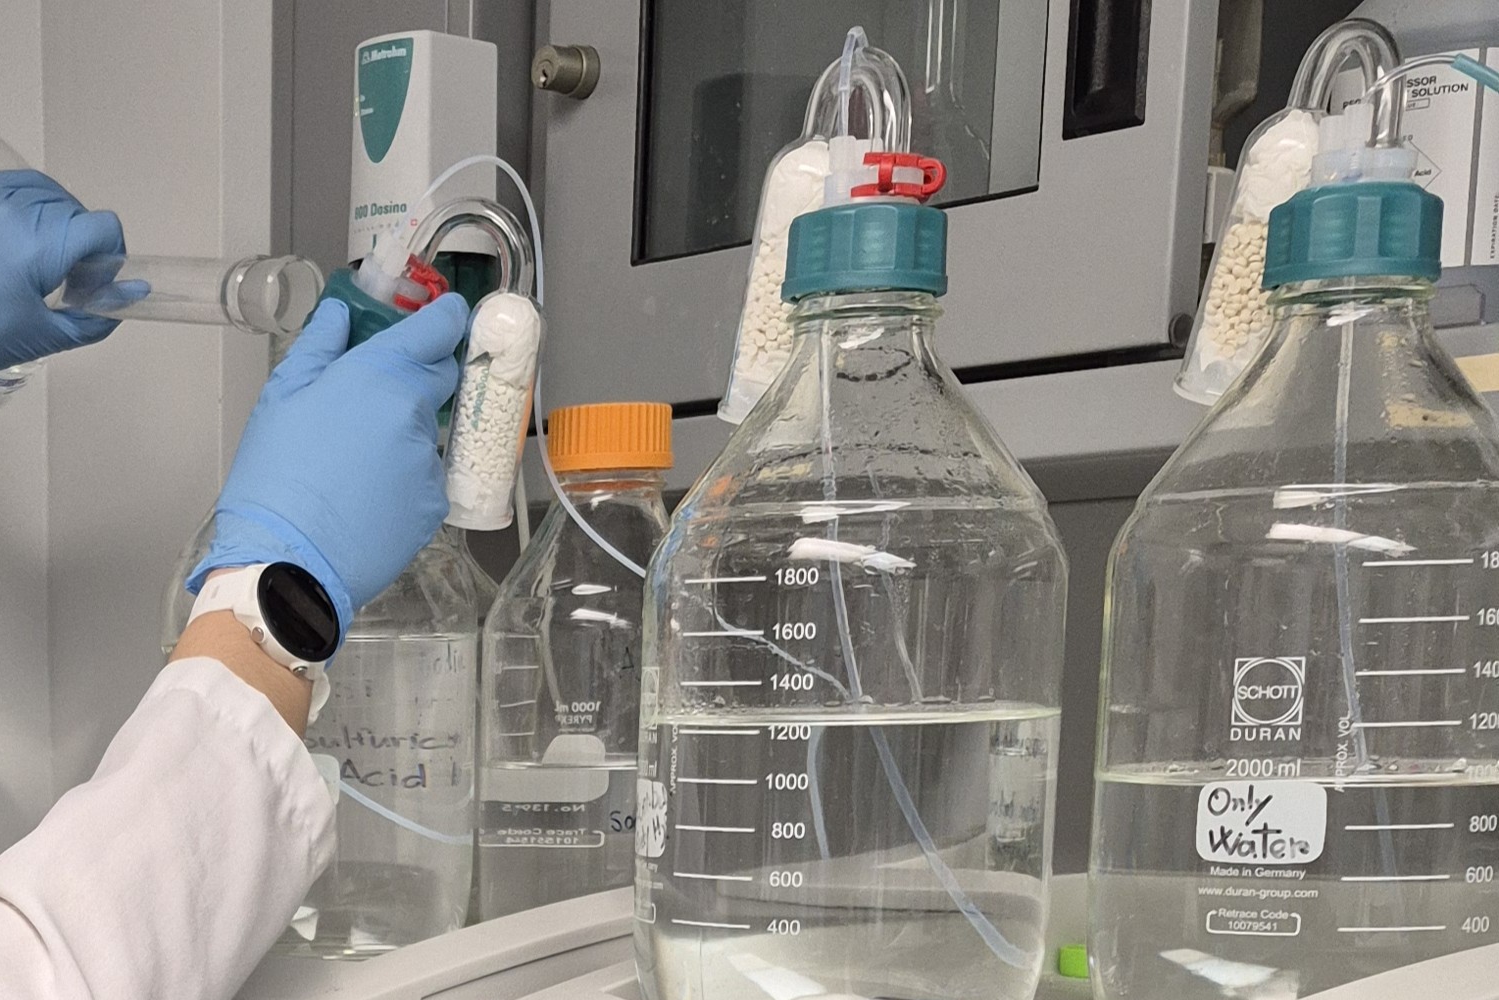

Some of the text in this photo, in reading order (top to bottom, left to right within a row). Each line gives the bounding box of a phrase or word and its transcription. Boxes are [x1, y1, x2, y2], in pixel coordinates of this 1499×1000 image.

[1406, 76, 1437, 88] SSOR
[1411, 83, 1469, 98] SOLUTION
[370, 202, 407, 217] Dosino
[1480, 550, 1499, 569] 18
[774, 567, 819, 586] 1800
[772, 622, 817, 640] 1600
[1473, 660, 1499, 678] 140
[770, 673, 814, 691] 1400
[1237, 685, 1298, 700] SCHOTT
[767, 724, 812, 741] 1200
[1230, 727, 1301, 741] DURAN
[339, 758, 427, 788] Acid
[1225, 758, 1301, 777] 2000 ml
[765, 773, 809, 790] 1000
[1207, 784, 1273, 826] Only
[771, 822, 806, 839] 800
[1469, 814, 1498, 833] 800
[1208, 822, 1311, 859] Water
[769, 871, 804, 888] 600
[1210, 866, 1306, 880] Made in Germany
[1465, 865, 1494, 884] 600
[1198, 886, 1319, 900] www.duran-group.com
[1218, 908, 1290, 920] Retrace Code
[767, 919, 801, 936] 400
[1227, 920, 1278, 932] 10079541
[1461, 916, 1490, 933] 400
